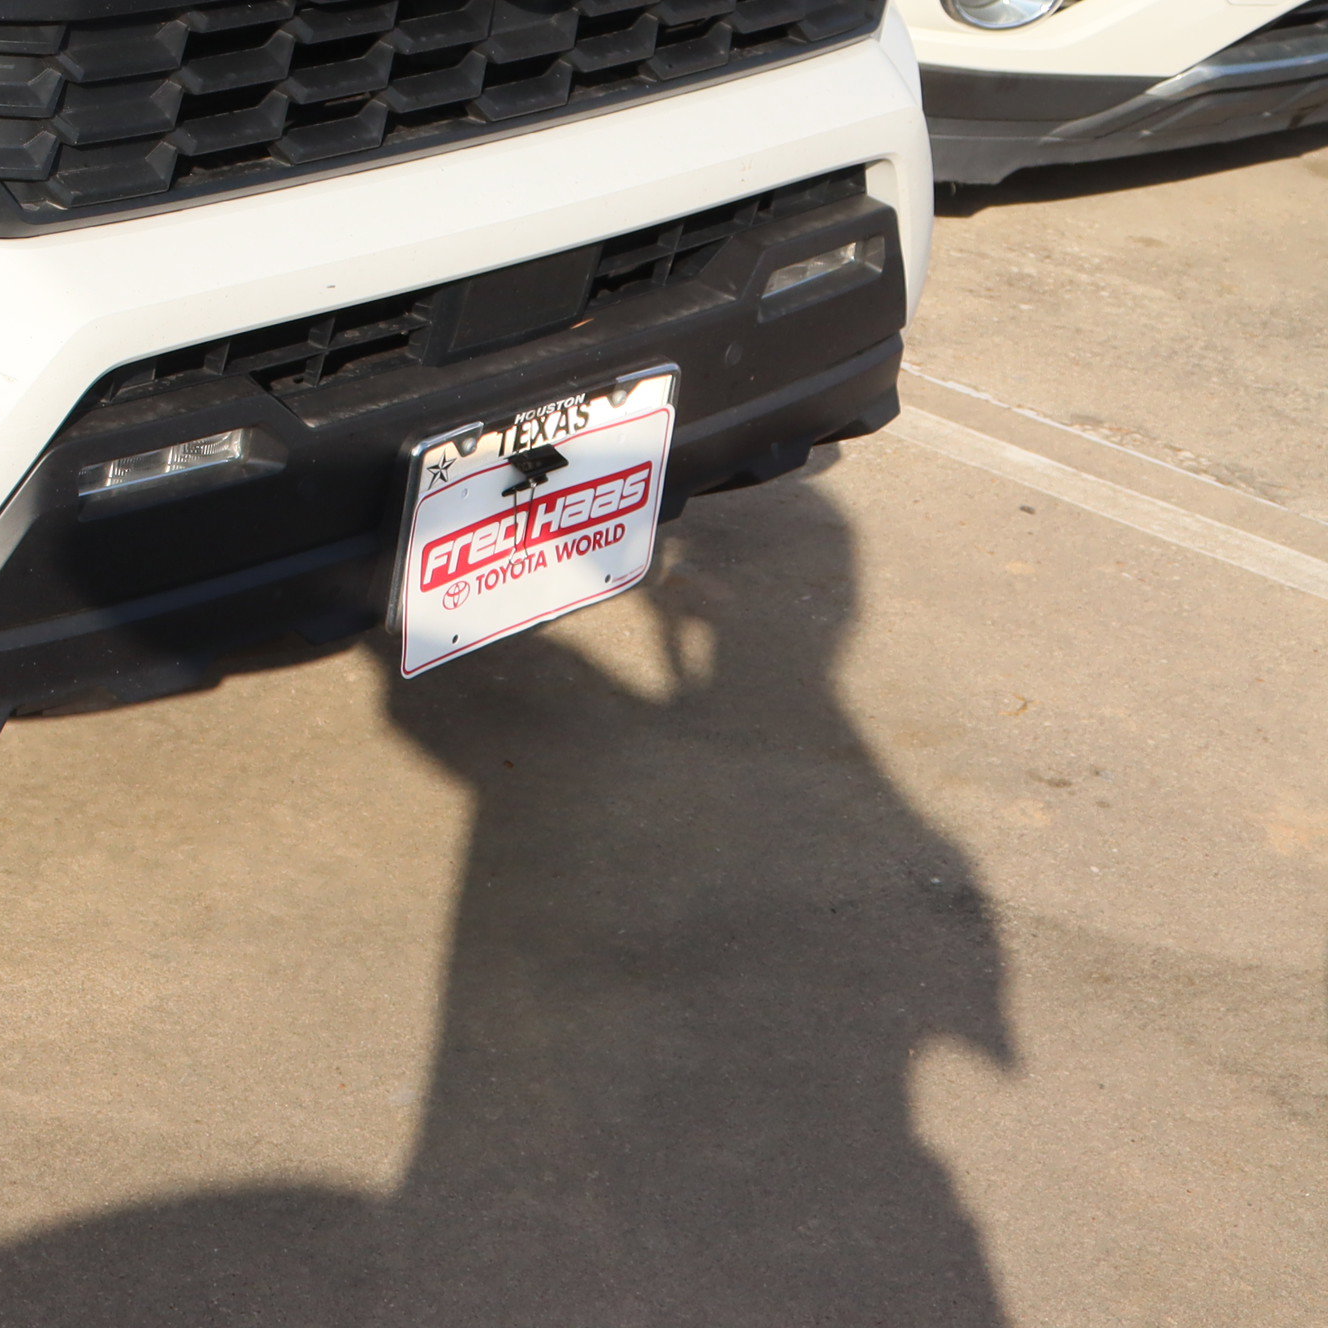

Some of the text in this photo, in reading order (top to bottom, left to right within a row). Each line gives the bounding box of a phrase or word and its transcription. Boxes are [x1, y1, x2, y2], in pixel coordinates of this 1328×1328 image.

[497, 403, 592, 458] TEXAS
[513, 392, 586, 425] HOUSTON
[475, 522, 627, 595] TOYOTA WORLD
